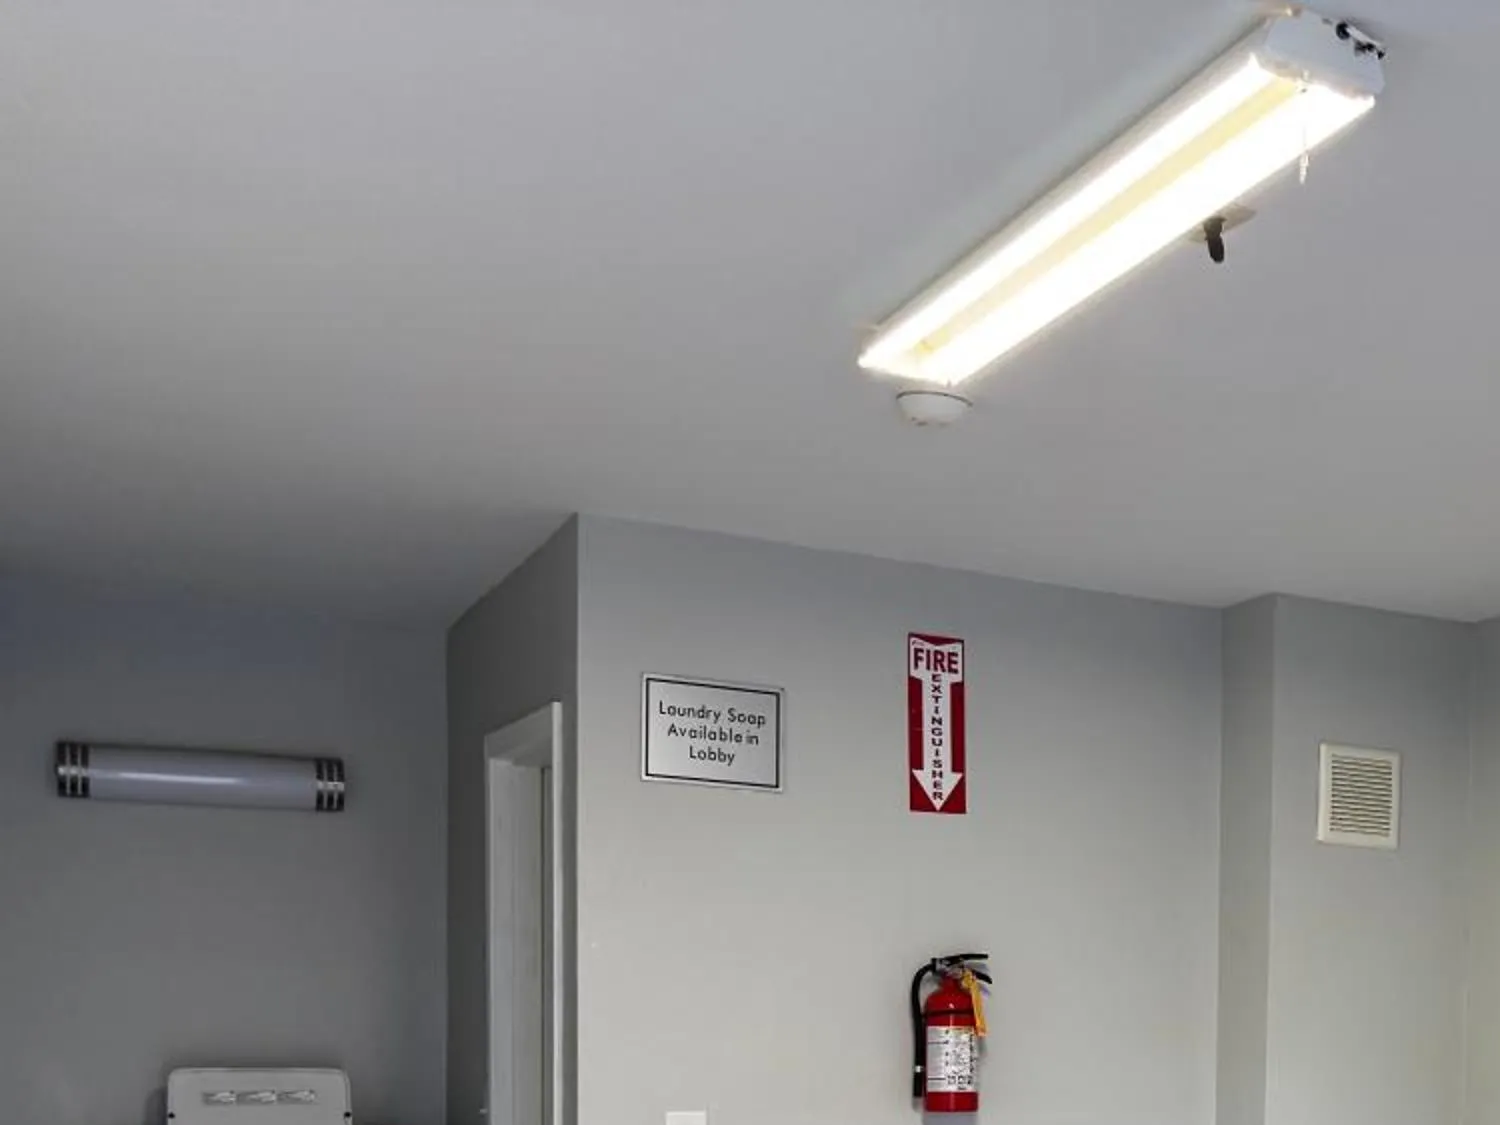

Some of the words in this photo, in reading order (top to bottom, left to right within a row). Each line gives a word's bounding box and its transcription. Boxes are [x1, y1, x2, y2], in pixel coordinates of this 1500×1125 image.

[914, 648, 959, 674] FIRE
[659, 700, 721, 723] Laundry
[727, 708, 766, 729] Soap
[667, 723, 743, 743] Available
[746, 730, 759, 745] in
[931, 674, 943, 800] EXTINGUISHER
[689, 745, 735, 766] Lobby
